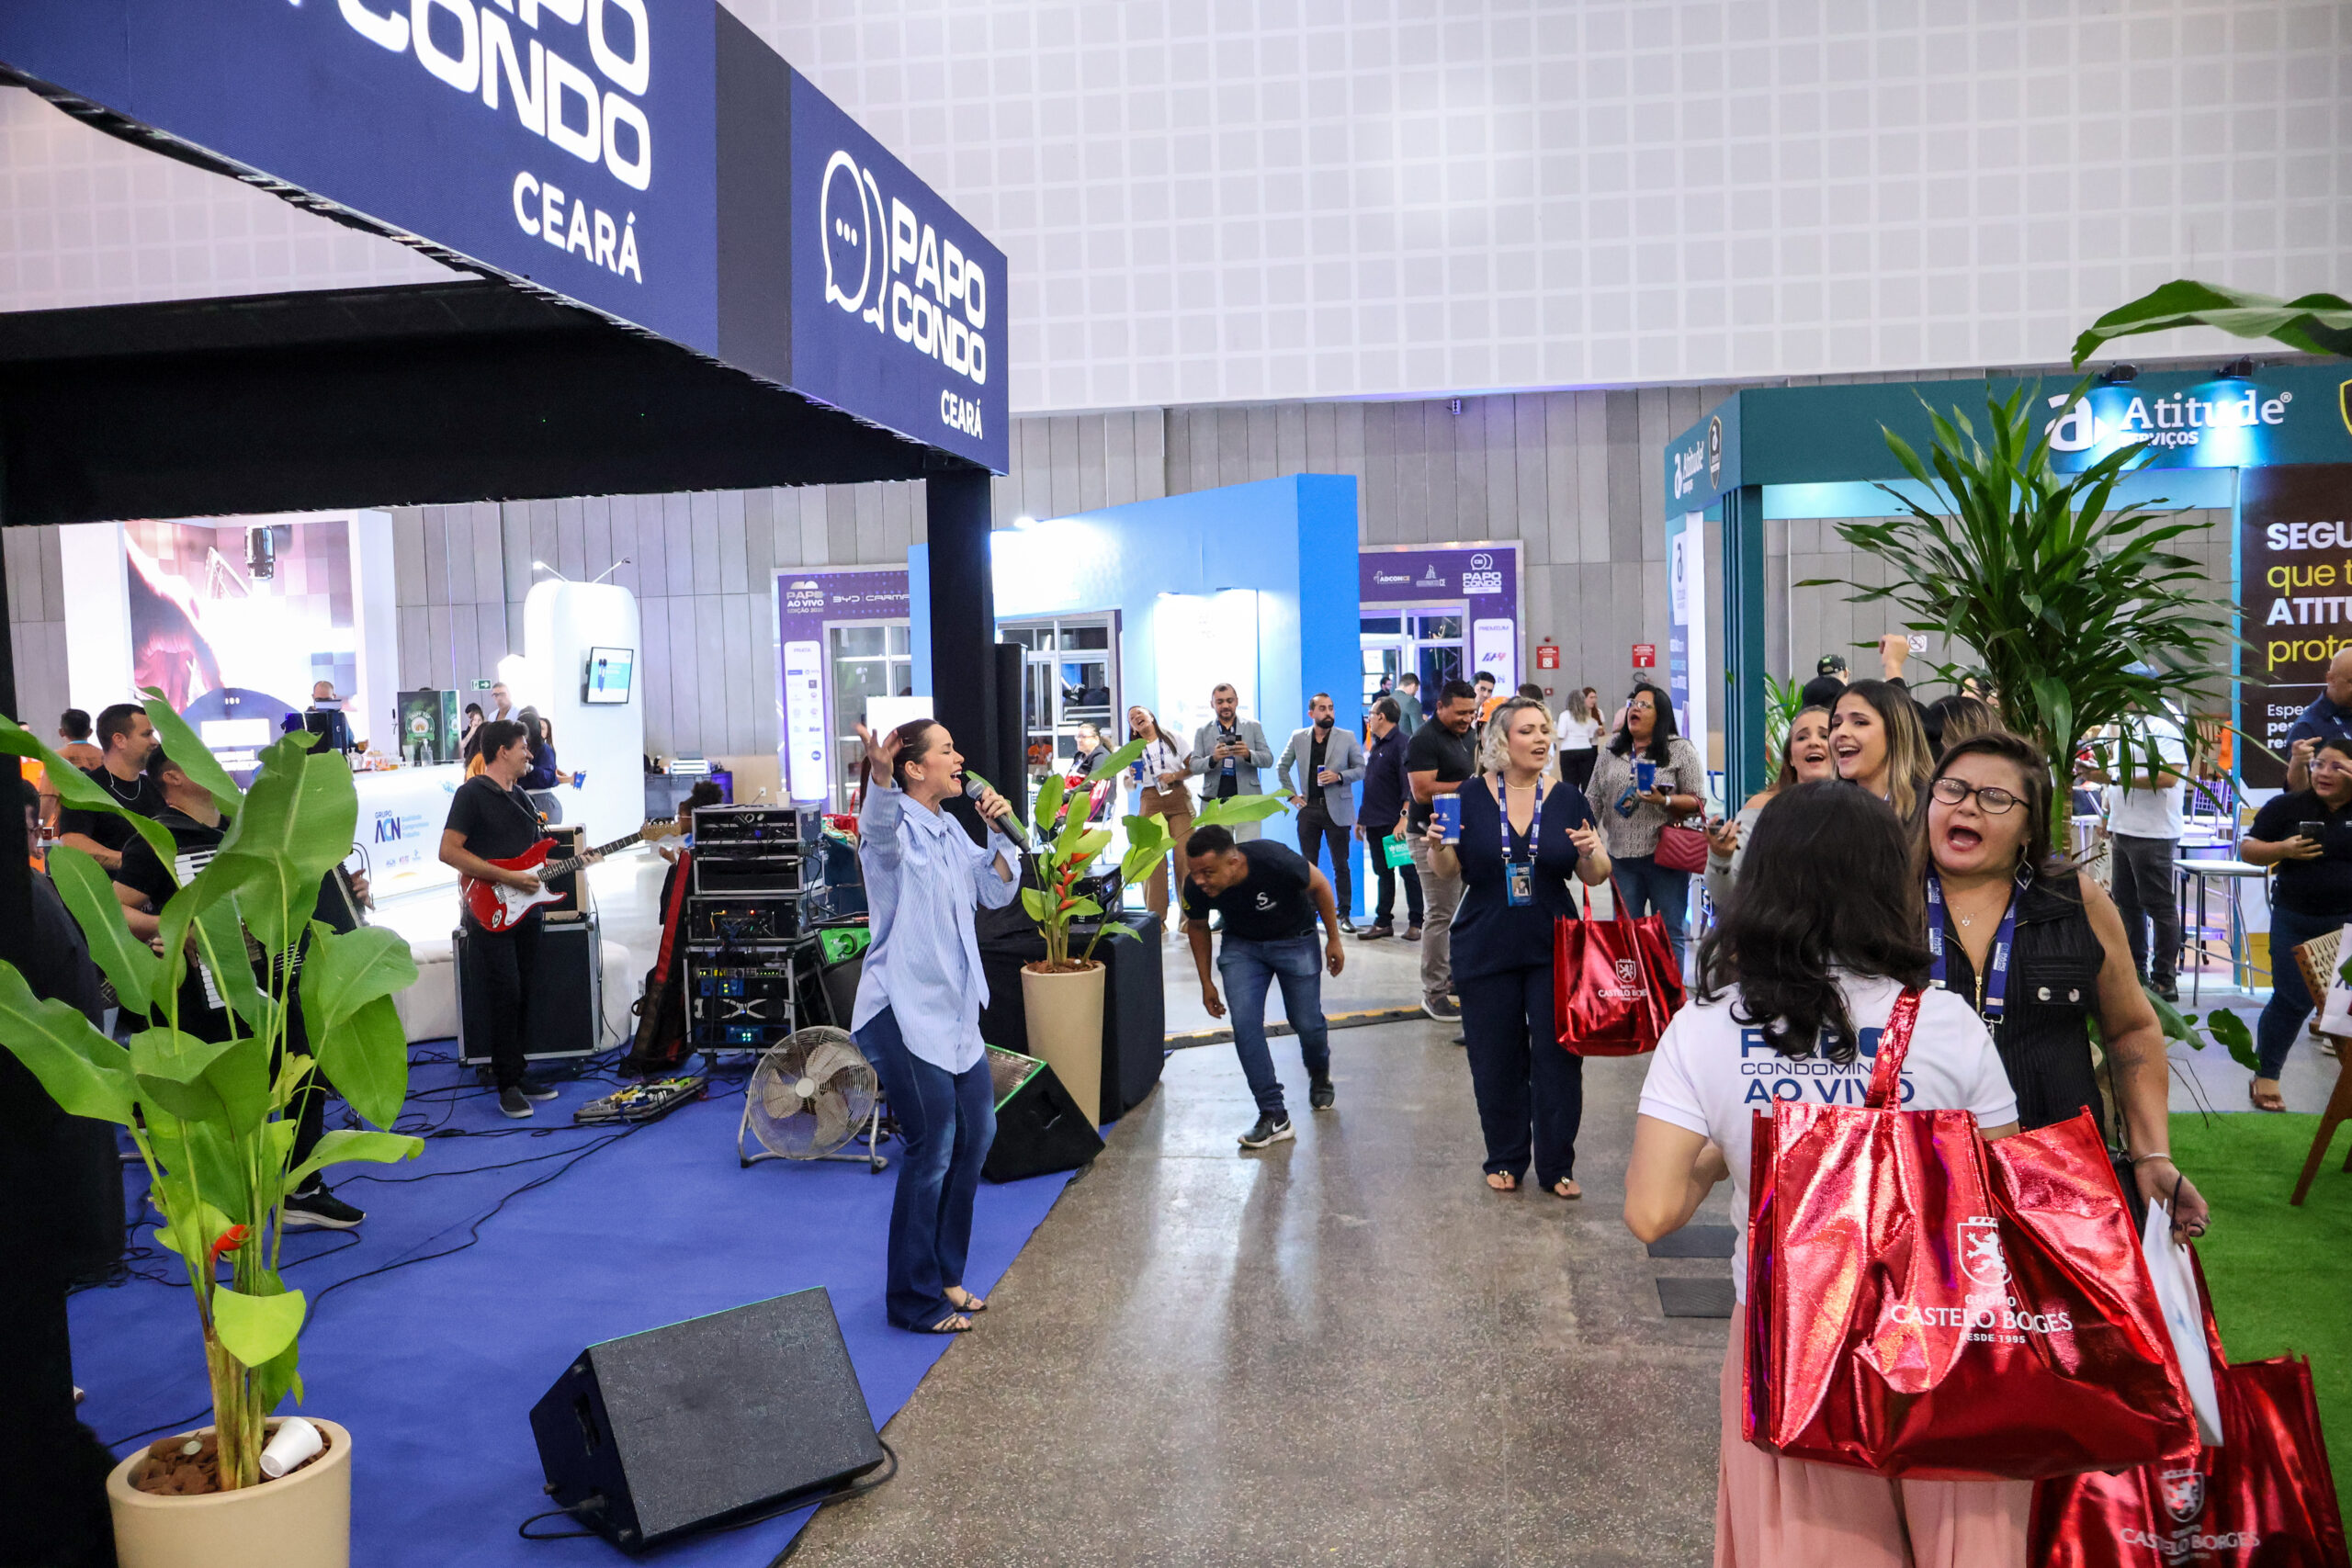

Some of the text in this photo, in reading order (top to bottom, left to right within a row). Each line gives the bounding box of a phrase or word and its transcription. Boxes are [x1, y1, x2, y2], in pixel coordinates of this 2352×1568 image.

[513, 171, 642, 284] CEARÁ
[892, 197, 986, 330] PAPO
[892, 280, 986, 385] CONDO
[941, 389, 982, 440] CEARÁ
[1463, 572, 1501, 581] PAPO
[2267, 565, 2336, 596] que
[802, 599, 824, 607] VIVO
[2267, 635, 2352, 671] prot
[2267, 704, 2310, 719] Espe
[375, 810, 392, 818] GRUPO
[1741, 1063, 1913, 1076] CONDOMINL
[1744, 1078, 1802, 1103] AO
[1891, 1304, 1996, 1328] CASTELO
[1998, 1334, 2026, 1344] 1995
